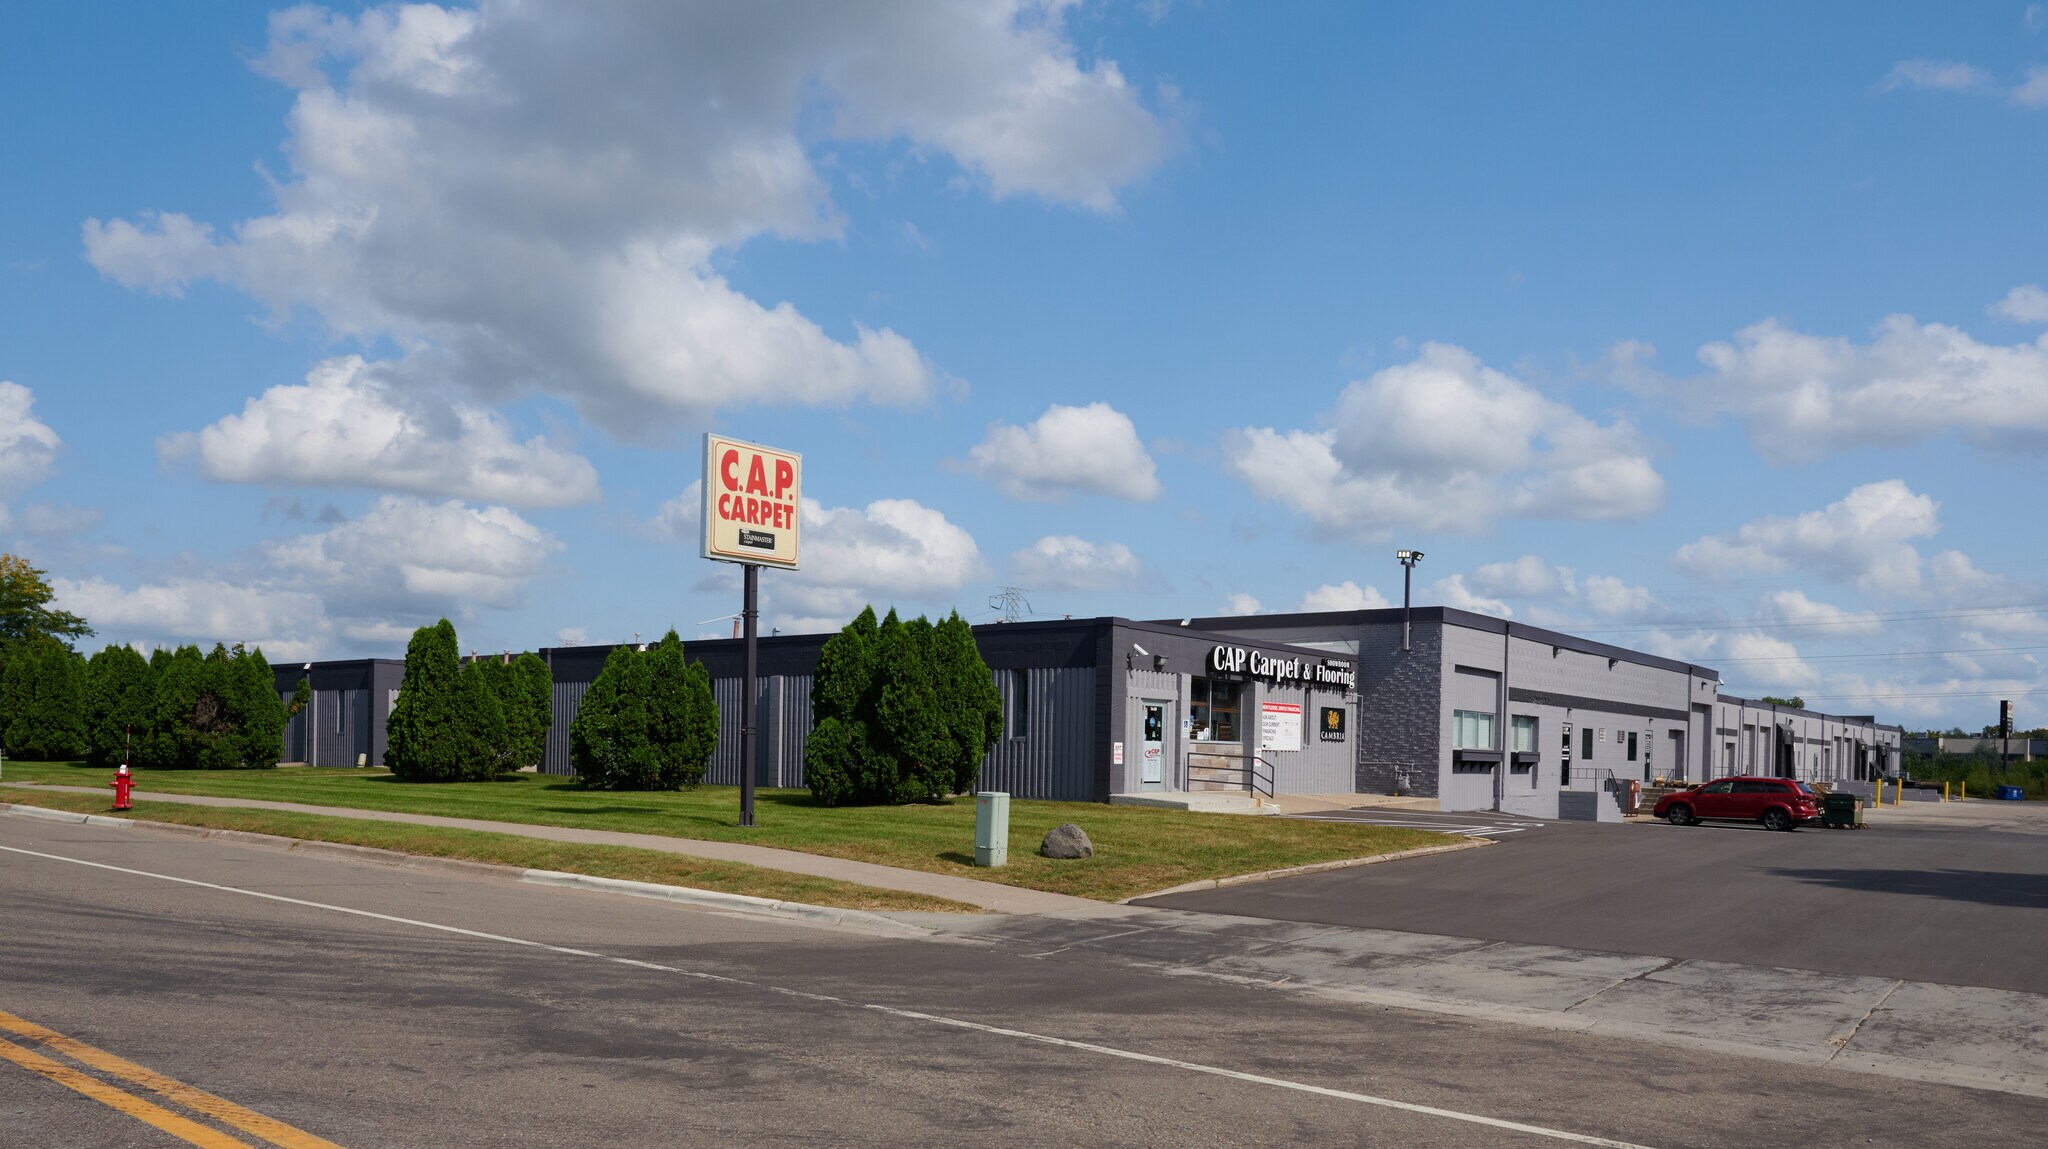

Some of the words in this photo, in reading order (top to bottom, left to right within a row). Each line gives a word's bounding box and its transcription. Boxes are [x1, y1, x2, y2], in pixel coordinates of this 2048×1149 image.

[721, 449, 793, 501] C.A.P.
[718, 493, 794, 530] CARPET
[1213, 645, 1246, 672] CAP
[1250, 650, 1299, 682] Carpet
[1303, 663, 1311, 680] &
[1316, 665, 1355, 689] Flooring
[1326, 660, 1350, 668] SHOWROOM
[1321, 732, 1345, 740] CAMBRIA
